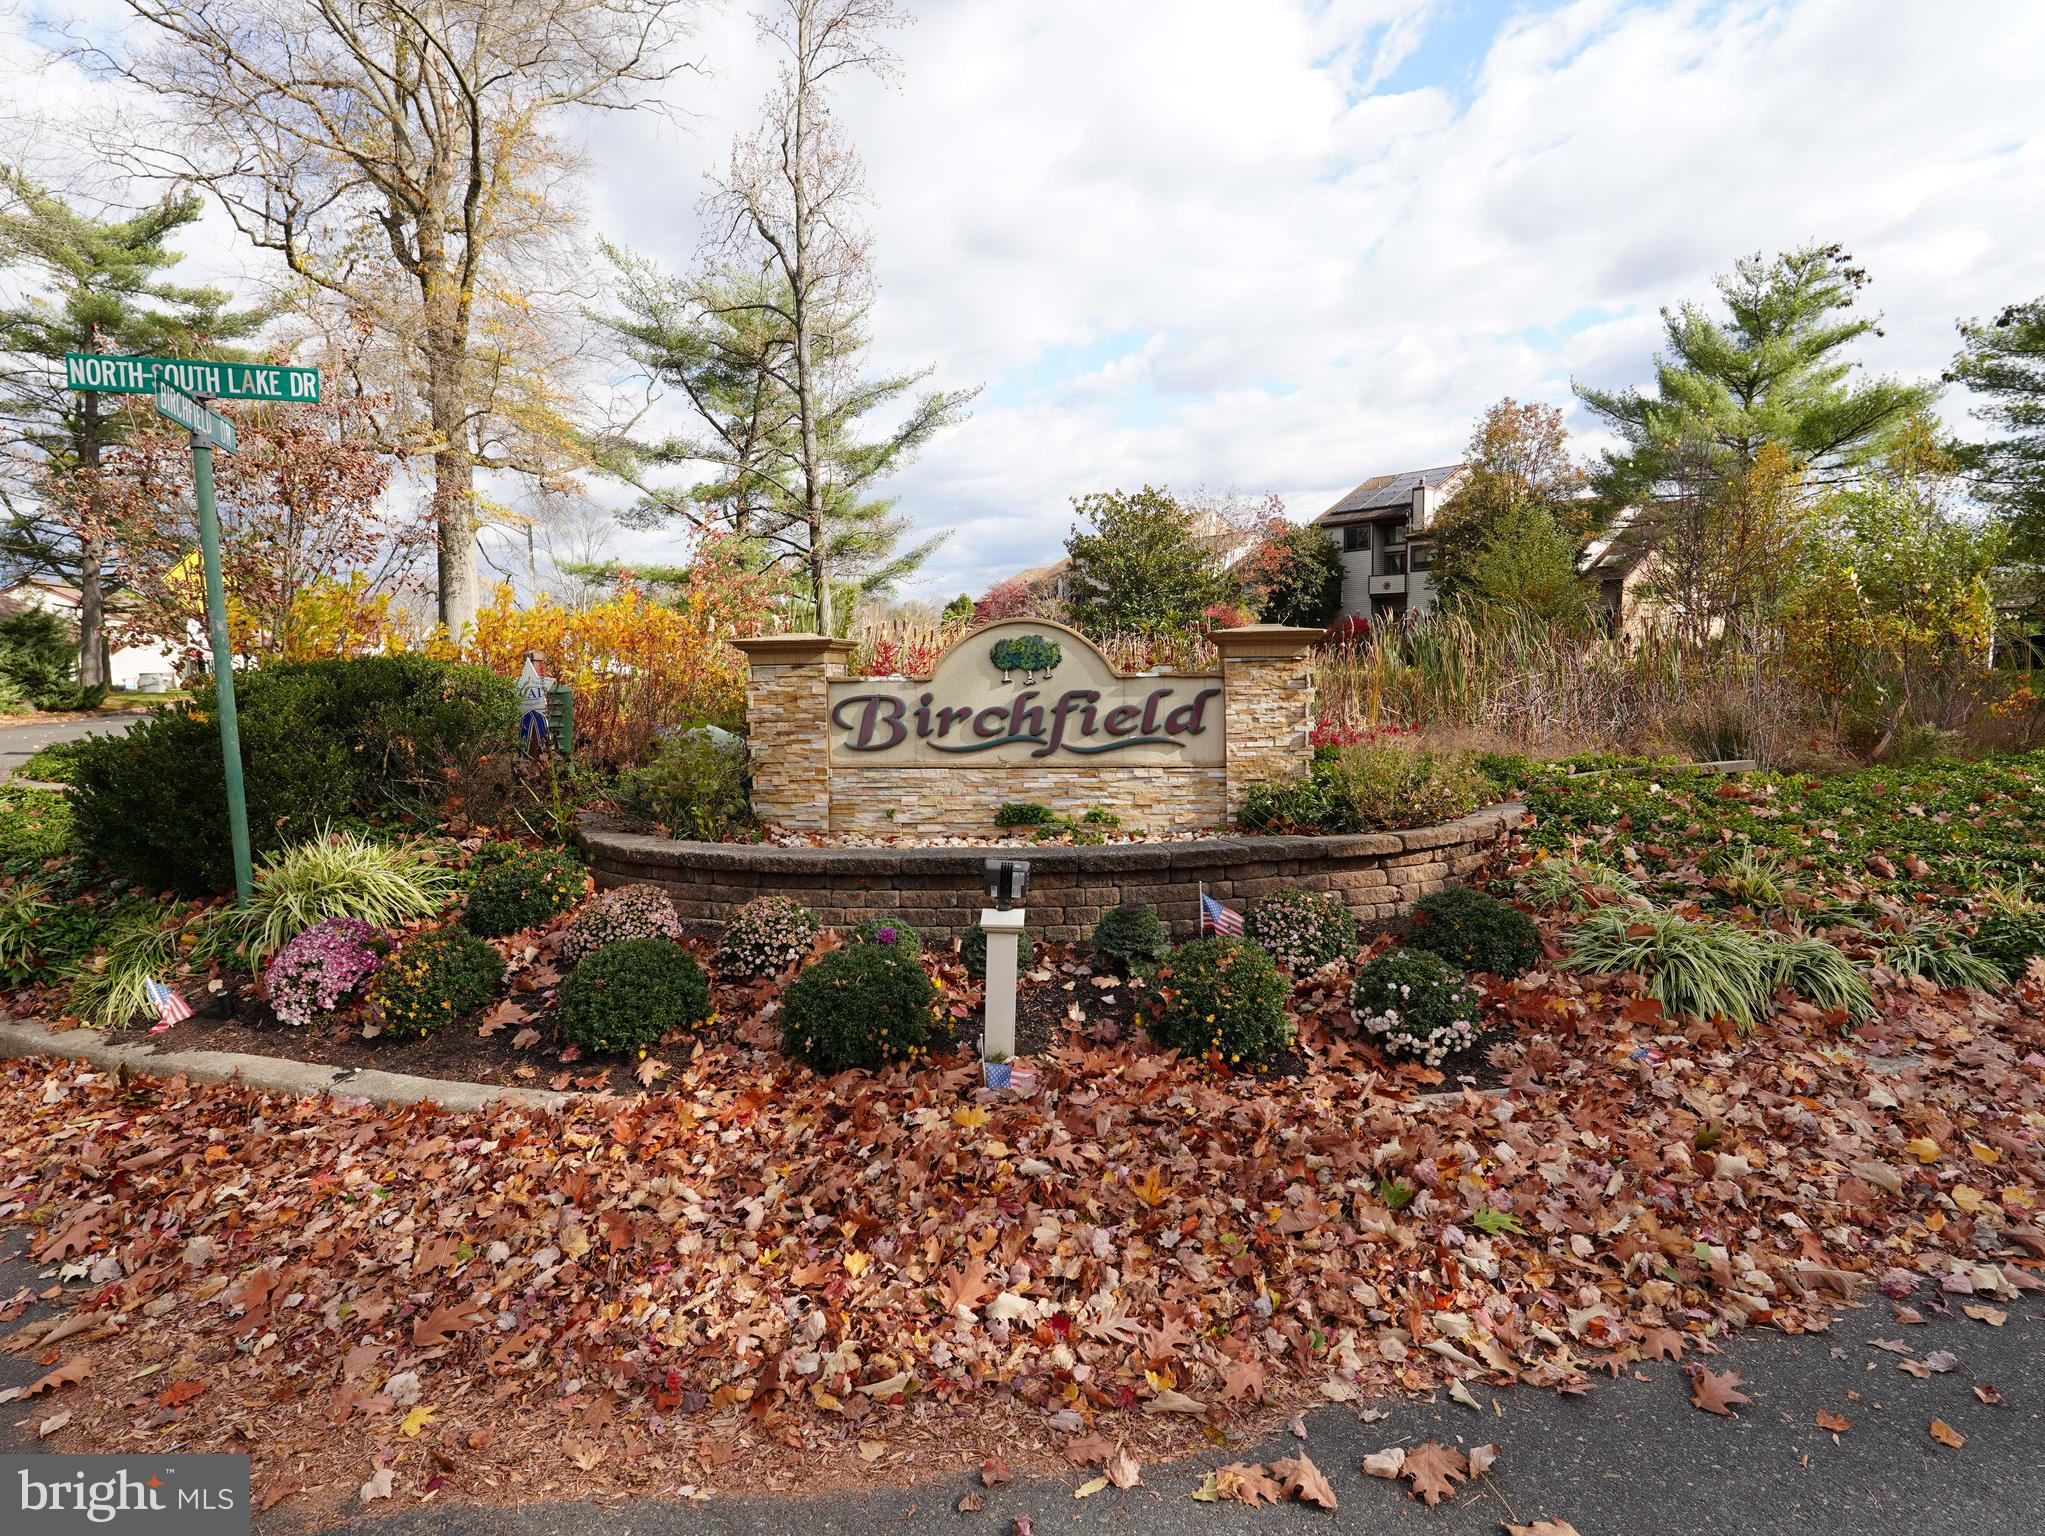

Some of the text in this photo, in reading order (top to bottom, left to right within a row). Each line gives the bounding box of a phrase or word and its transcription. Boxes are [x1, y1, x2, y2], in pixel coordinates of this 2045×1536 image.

[68, 357, 317, 398] NORTH-SOUTH LAKE DR
[160, 381, 232, 449] BIRCHFIELD DR
[831, 687, 1222, 757] Birchfield
